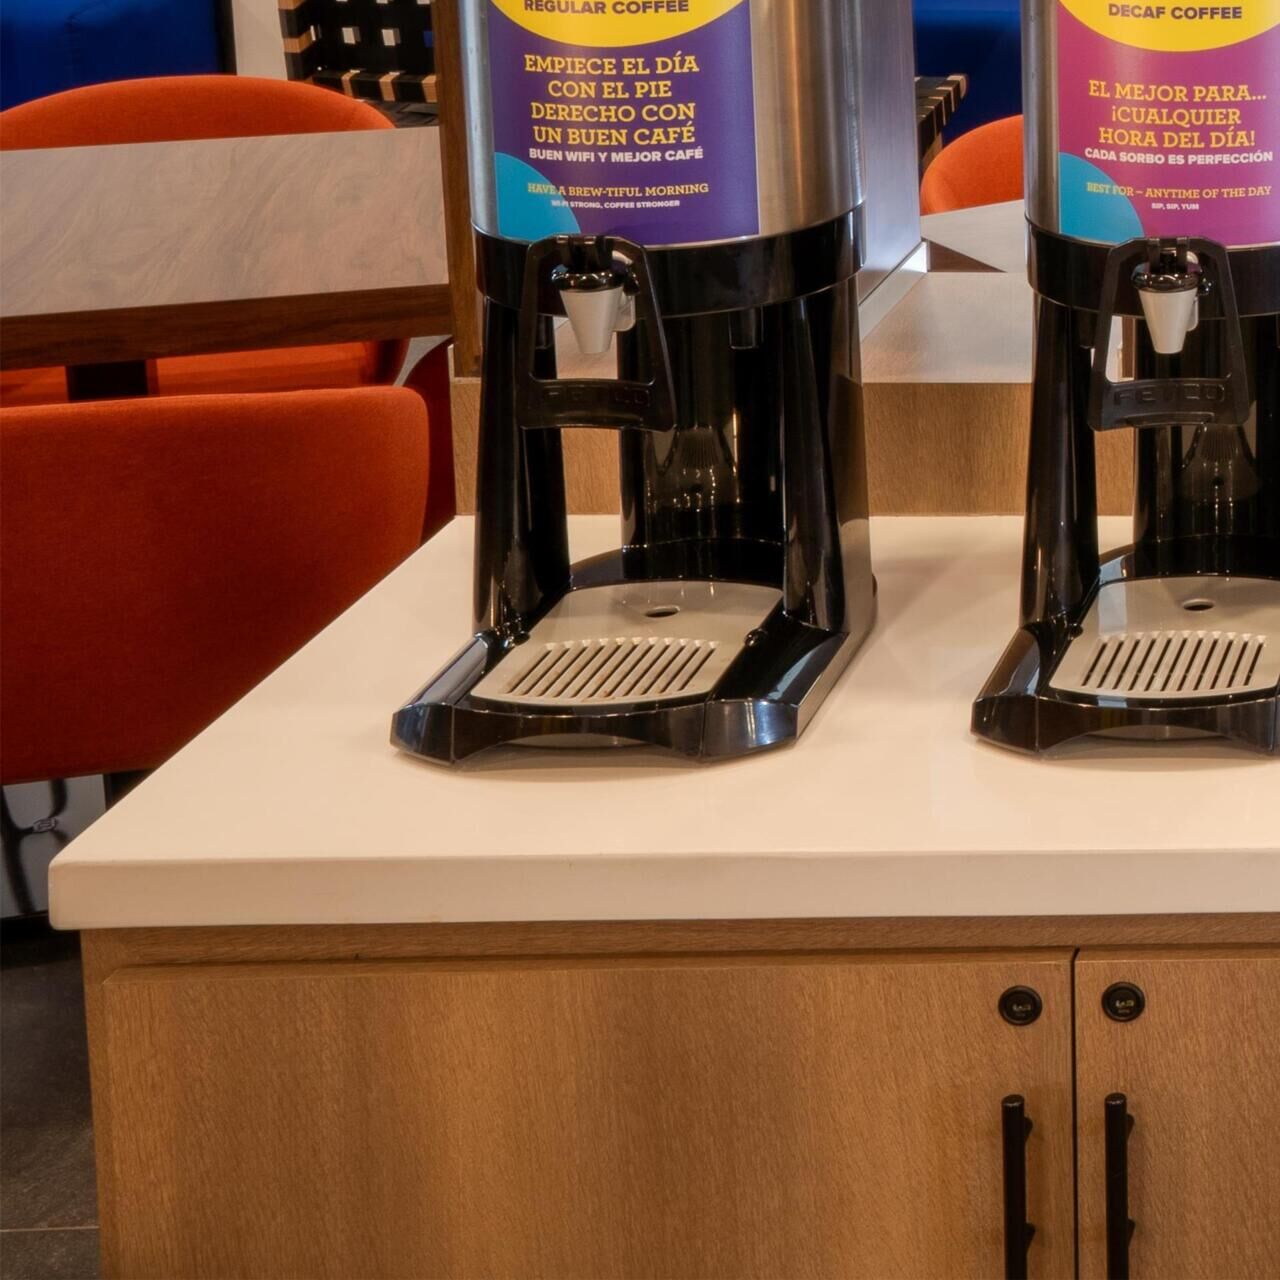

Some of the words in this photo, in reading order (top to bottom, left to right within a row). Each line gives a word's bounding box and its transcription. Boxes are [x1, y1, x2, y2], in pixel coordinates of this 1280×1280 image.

[612, 0, 689, 14] COFFEE
[1108, 3, 1166, 19] DECAF
[1170, 6, 1243, 20] COFFEE
[524, 54, 617, 75] EMPIECE
[622, 58, 650, 75] EL
[655, 50, 700, 73] DÍA
[548, 80, 596, 98] CON
[601, 82, 629, 99] EL
[634, 81, 672, 98] PIE
[1089, 79, 1110, 98] EL
[1114, 83, 1189, 102] MEJOR
[1193, 84, 1267, 102] PARA...
[530, 102, 636, 122] DERECHO
[642, 103, 696, 121] CON
[1111, 105, 1242, 128] ¡CUALQUIER
[532, 126, 562, 144] UN
[567, 128, 628, 146] BUEN
[633, 121, 696, 145] CAFÉ
[1098, 127, 1158, 147] HORA
[1162, 131, 1205, 148] DEL
[1209, 126, 1256, 148] DÍA!
[529, 148, 563, 161] BUEN
[564, 150, 595, 162] WIFI
[597, 151, 608, 163] Y
[611, 151, 662, 163] MEJOR
[664, 145, 704, 160] CAFÉ
[1084, 147, 1117, 162] CADA
[1119, 151, 1165, 164] SORBO
[1168, 154, 1185, 165] ES
[1187, 150, 1274, 165] PERFECCIÓN
[527, 182, 557, 195] HAVE
[558, 185, 567, 196] A
[568, 185, 643, 197] BREW-TIFUL
[645, 183, 709, 197] MORNING
[1086, 182, 1112, 194] BEST
[1112, 185, 1135, 197] FOR
[1145, 188, 1200, 199] ANYTIME
[1202, 188, 1219, 199] OF
[1221, 187, 1246, 198] THE
[1247, 185, 1272, 197] DAY
[604, 201, 635, 209] COFFEE
[636, 199, 681, 209] STRONGER
